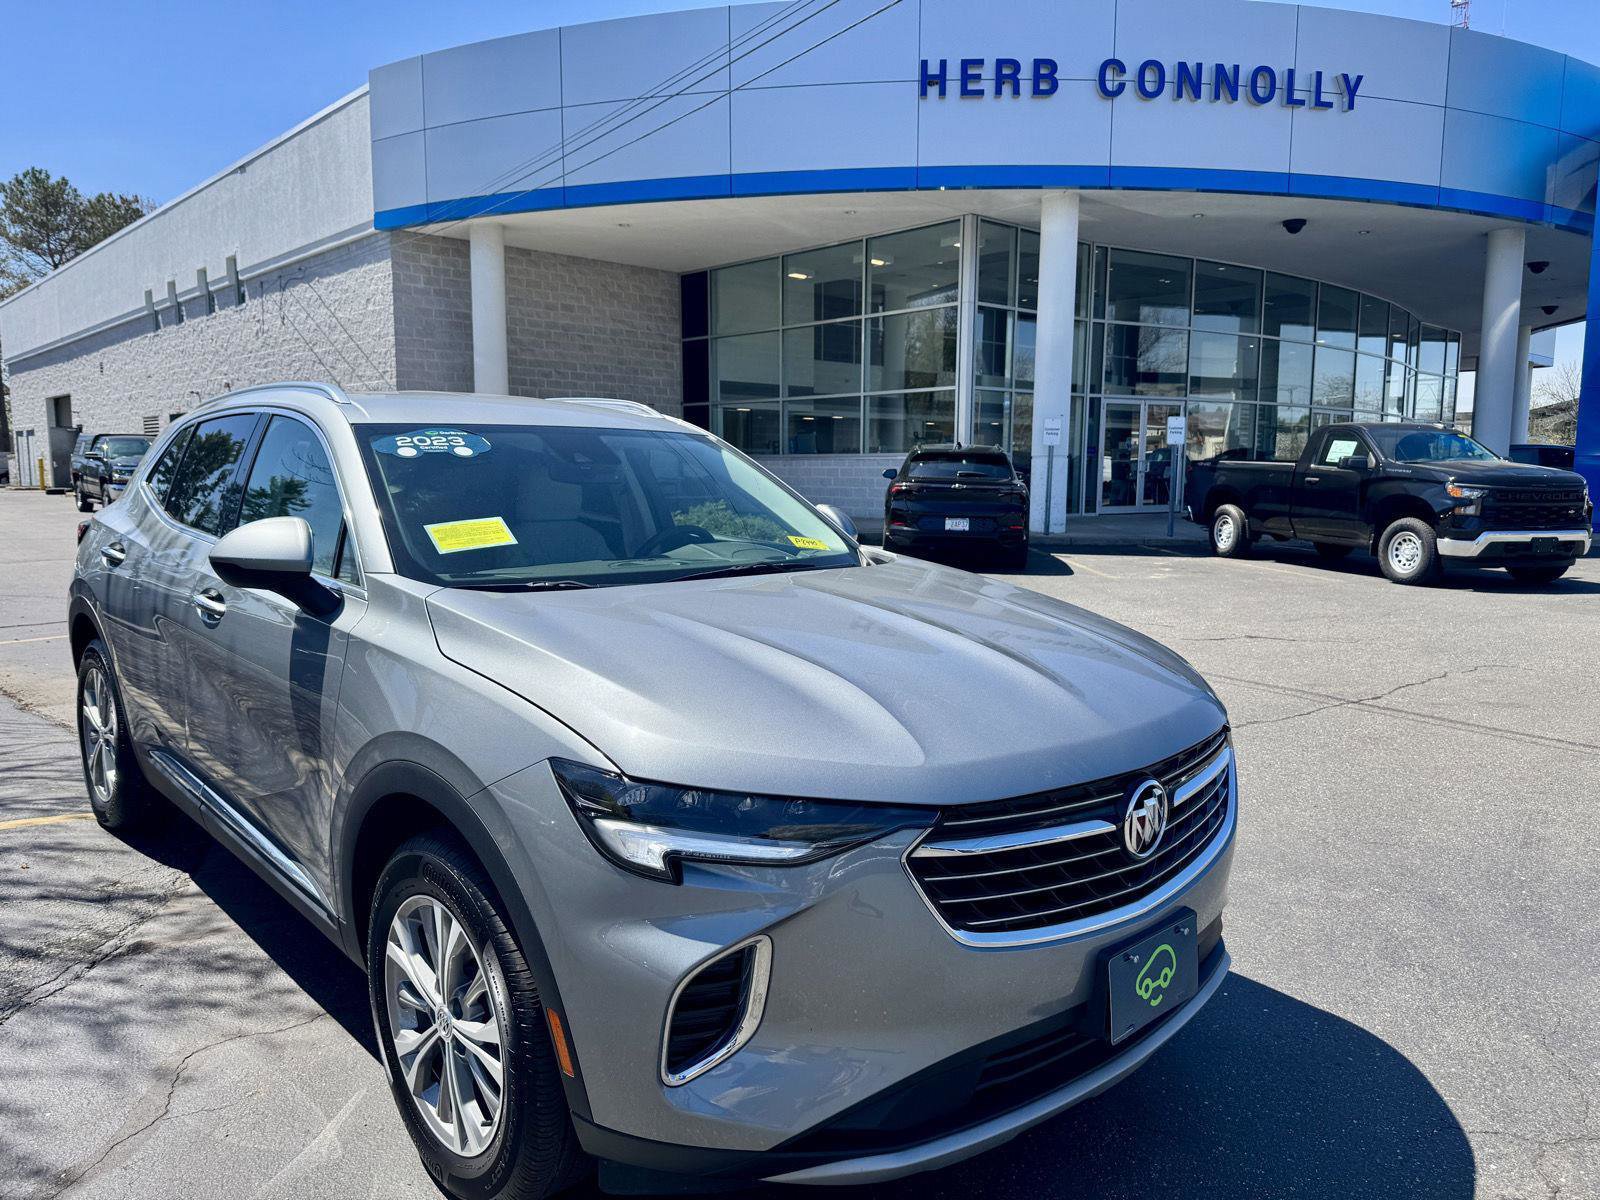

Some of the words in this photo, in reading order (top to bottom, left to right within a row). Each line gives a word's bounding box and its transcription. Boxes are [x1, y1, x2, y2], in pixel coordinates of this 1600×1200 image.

[920, 58, 1059, 99] HERB
[1096, 58, 1364, 112] CONNOLLY
[395, 436, 466, 446] 2023
